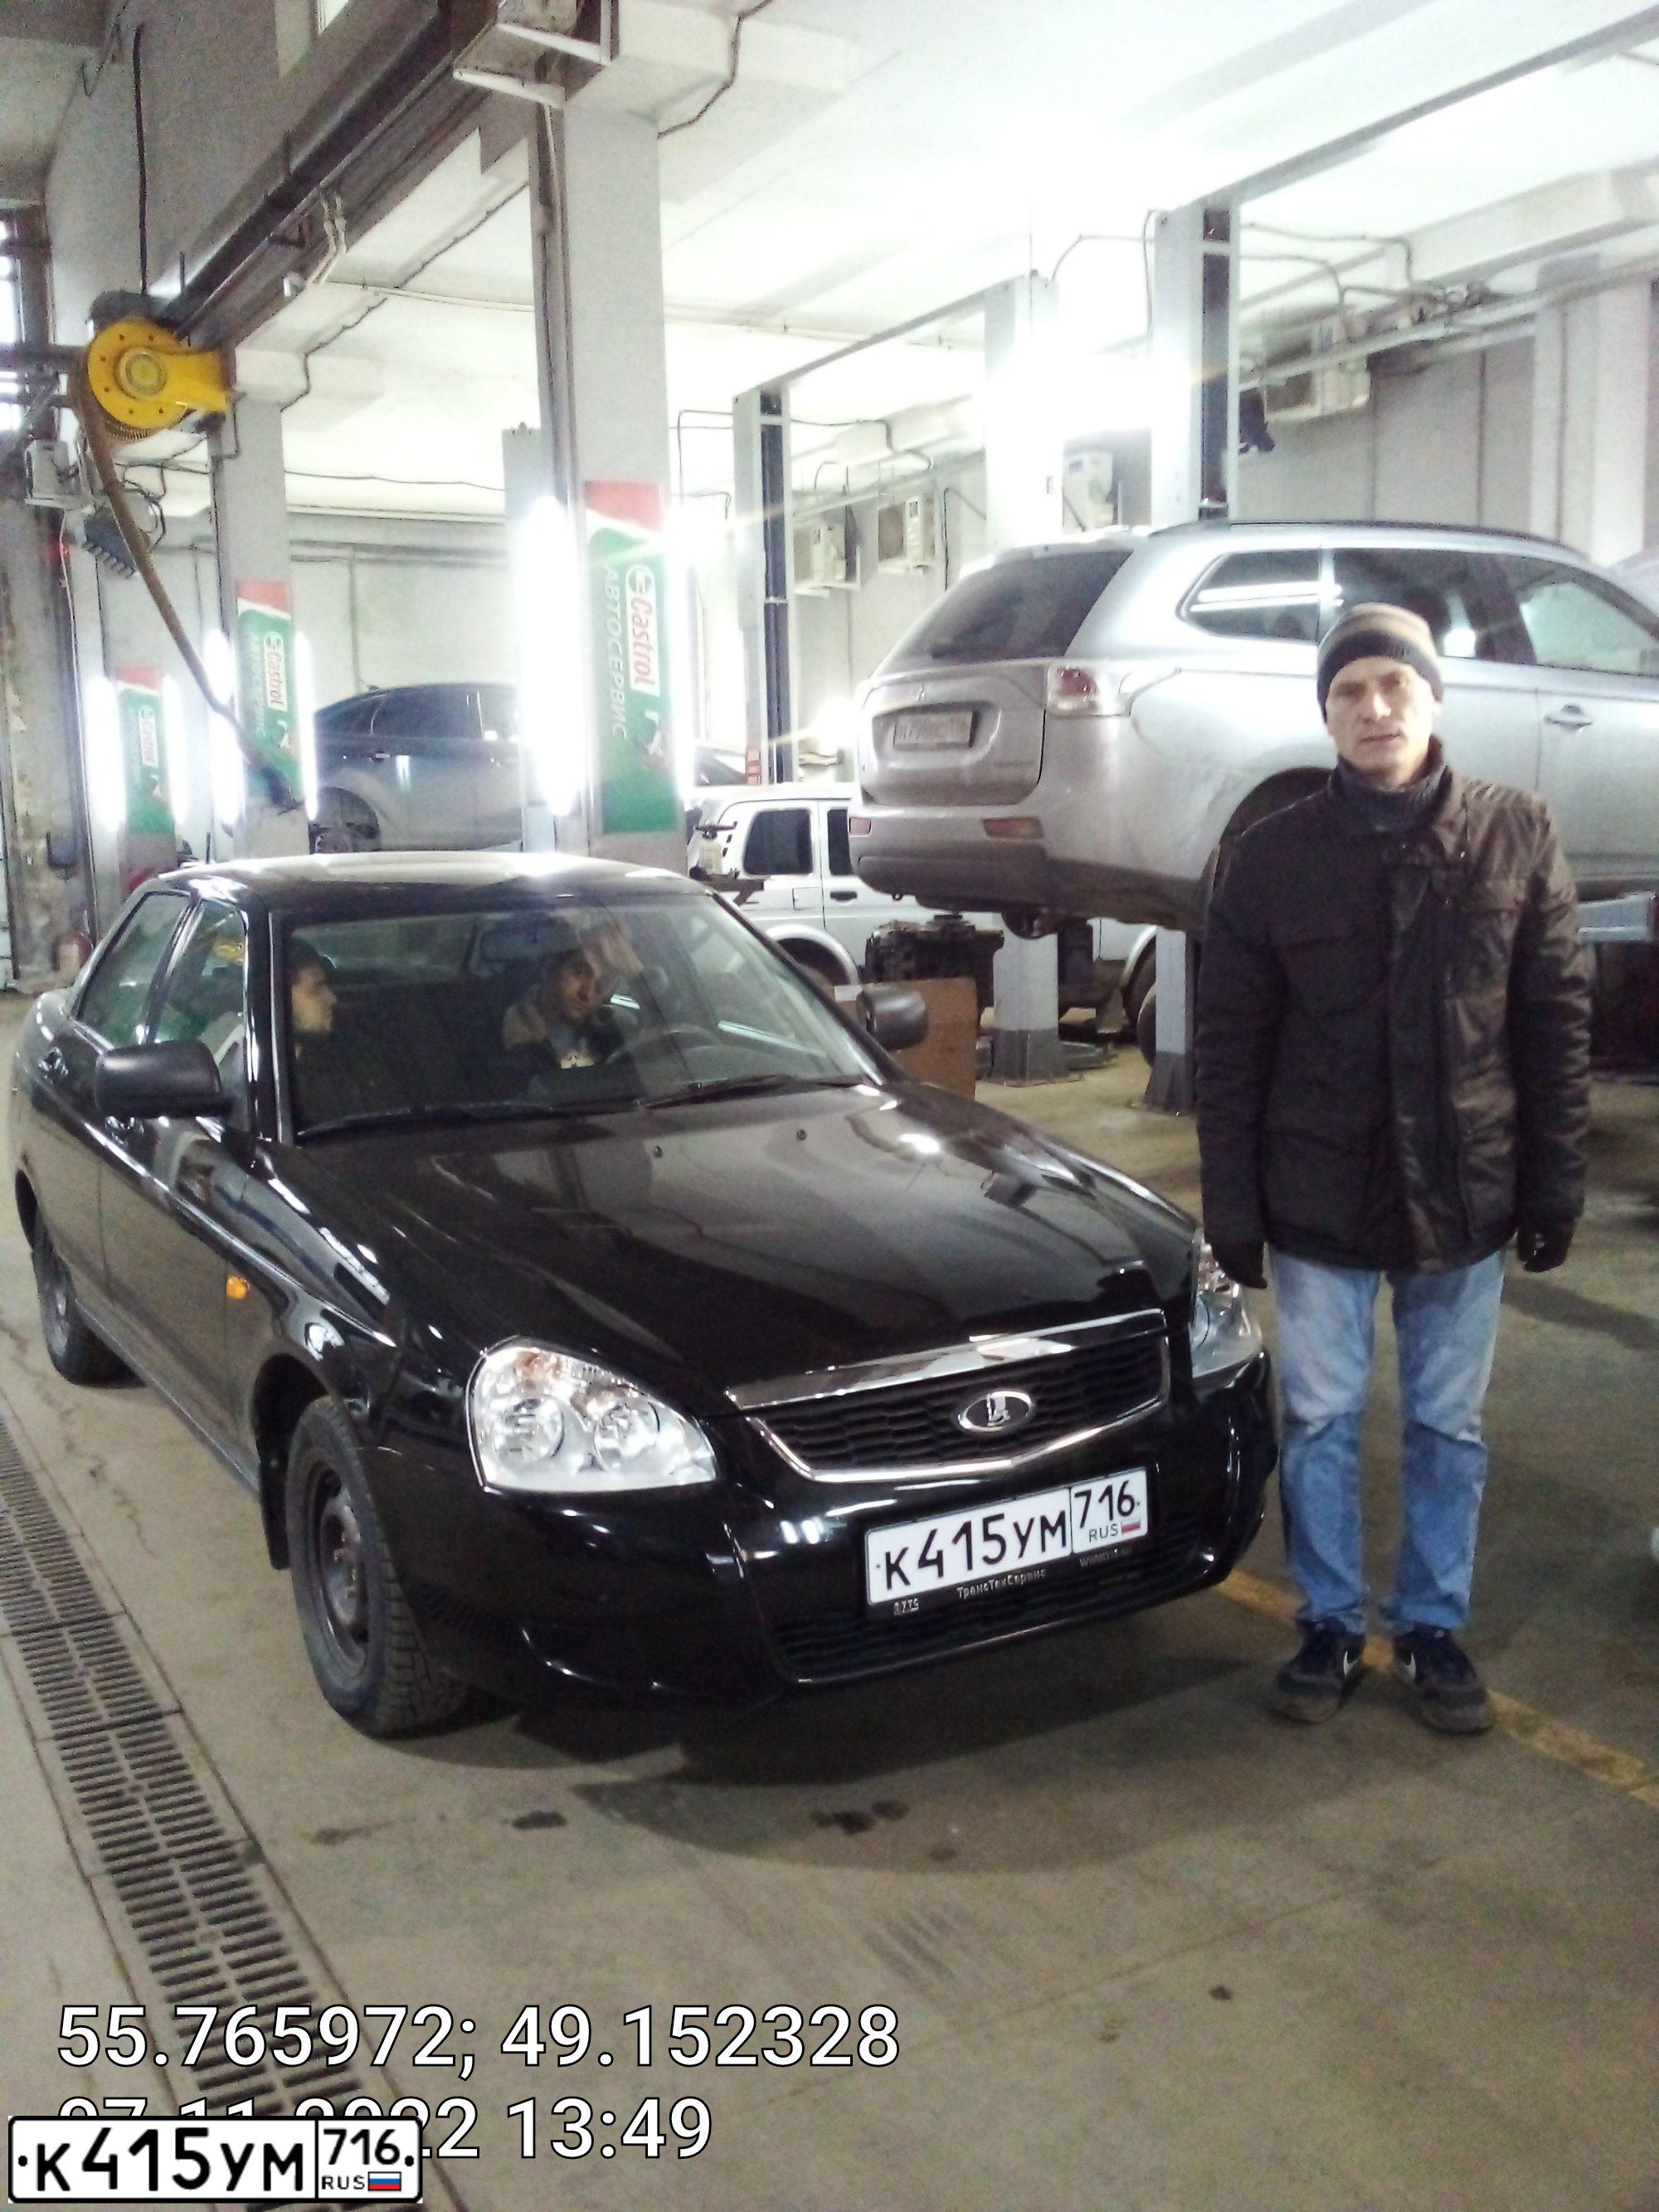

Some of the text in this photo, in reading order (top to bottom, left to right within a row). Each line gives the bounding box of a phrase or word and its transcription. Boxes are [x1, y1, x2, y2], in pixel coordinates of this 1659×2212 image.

[603, 566, 627, 740] АВТОСЕРВИС
[630, 596, 655, 686] Castrol
[267, 650, 285, 705] Castrol
[1074, 1480, 1136, 1529] 716
[1088, 1523, 1119, 1542] RUS
